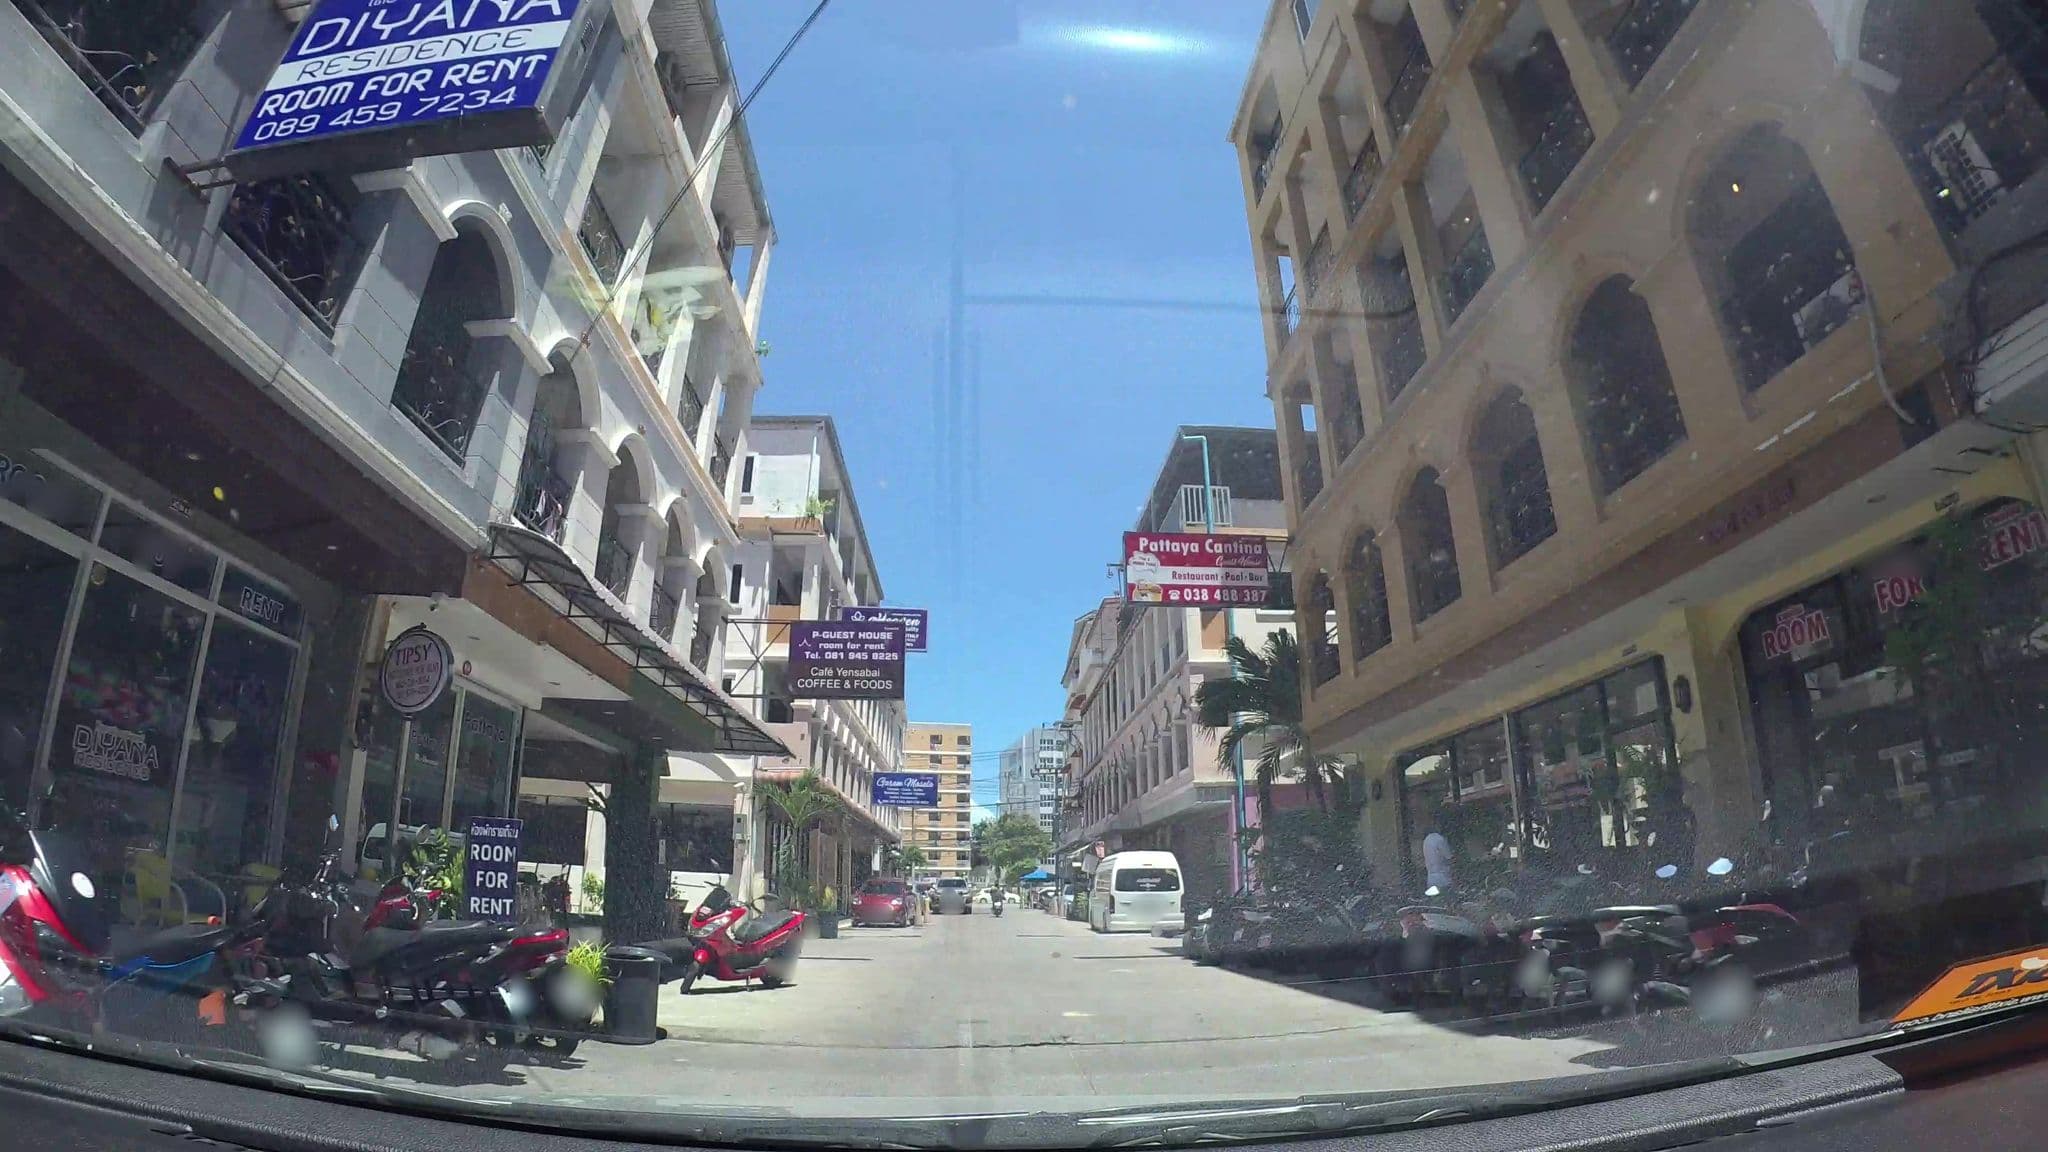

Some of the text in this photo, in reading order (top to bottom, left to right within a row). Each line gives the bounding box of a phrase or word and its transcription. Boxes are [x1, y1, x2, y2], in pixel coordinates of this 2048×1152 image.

[297, 28, 533, 81] RESIDENCE
[257, 54, 548, 118] ROOM FOR RENT
[254, 86, 517, 140] 089 459 7234
[1139, 537, 1263, 556] Pattaya Cantina
[1171, 571, 1263, 582] Restaurant Pool Bar
[1183, 588, 1267, 602] 038 488 387
[240, 586, 284, 624] RENT
[812, 631, 893, 640] P-GUEST HOUSE
[1762, 610, 1830, 660] ROOM
[396, 641, 434, 666] TIPSY
[804, 651, 820, 659] Tel.
[825, 651, 844, 659] 081
[848, 652, 868, 660] 945
[810, 667, 880, 677] Café Yensabai
[797, 679, 893, 689] COFFEE & FOODS
[72, 724, 159, 769] DIYANA
[471, 843, 517, 863] ROOM
[475, 870, 508, 889] FOR
[470, 896, 513, 915] RENT
